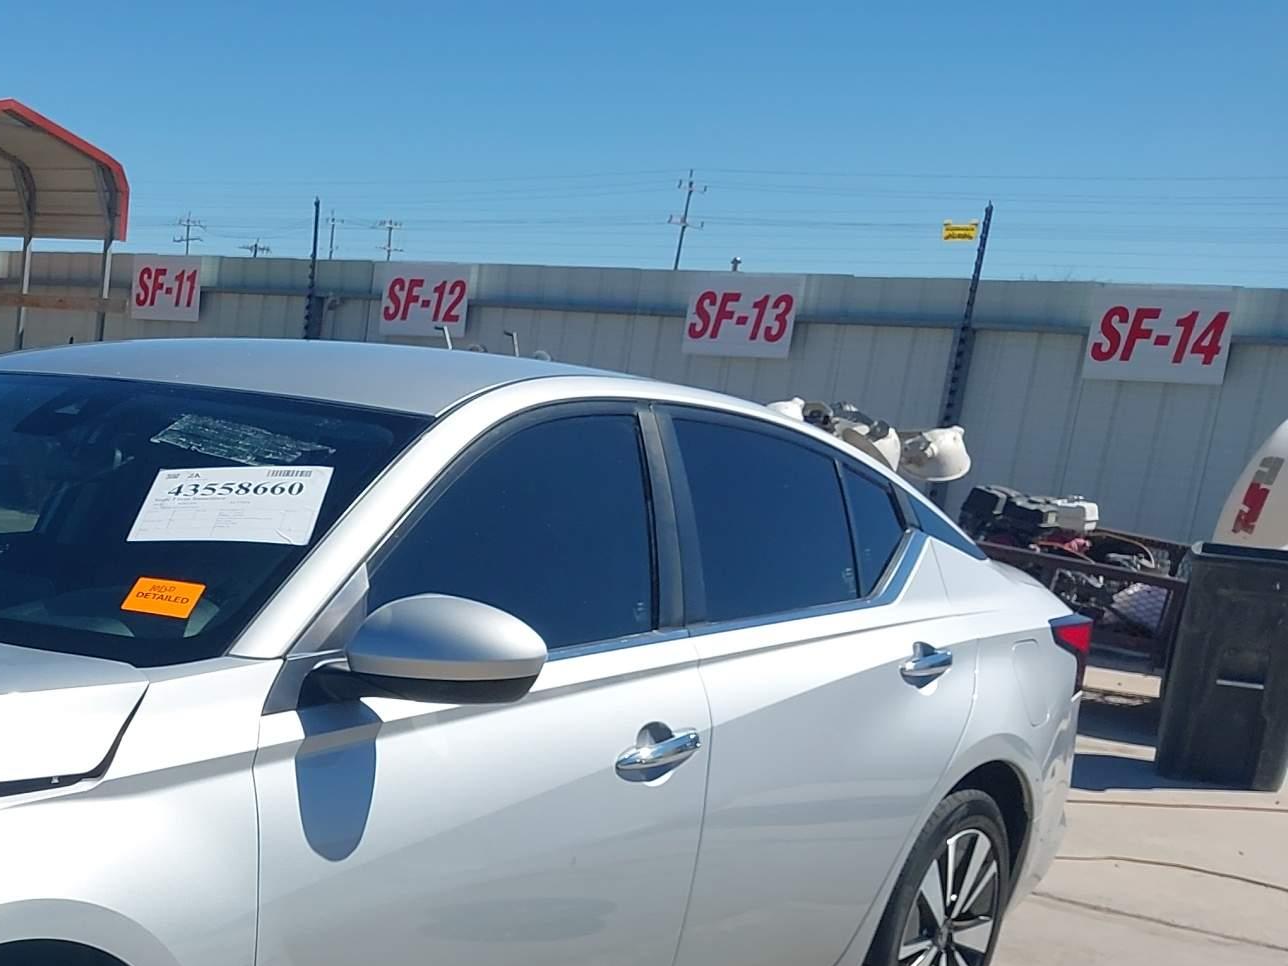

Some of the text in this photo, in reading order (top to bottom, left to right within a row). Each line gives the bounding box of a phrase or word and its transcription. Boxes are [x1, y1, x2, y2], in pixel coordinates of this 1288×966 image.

[135, 267, 197, 307] SF-11
[383, 277, 467, 322] SF-12
[688, 290, 794, 342] SF-13
[1090, 306, 1231, 366] SF-14
[167, 481, 304, 496] 43558660
[135, 591, 190, 604] DETAILED
